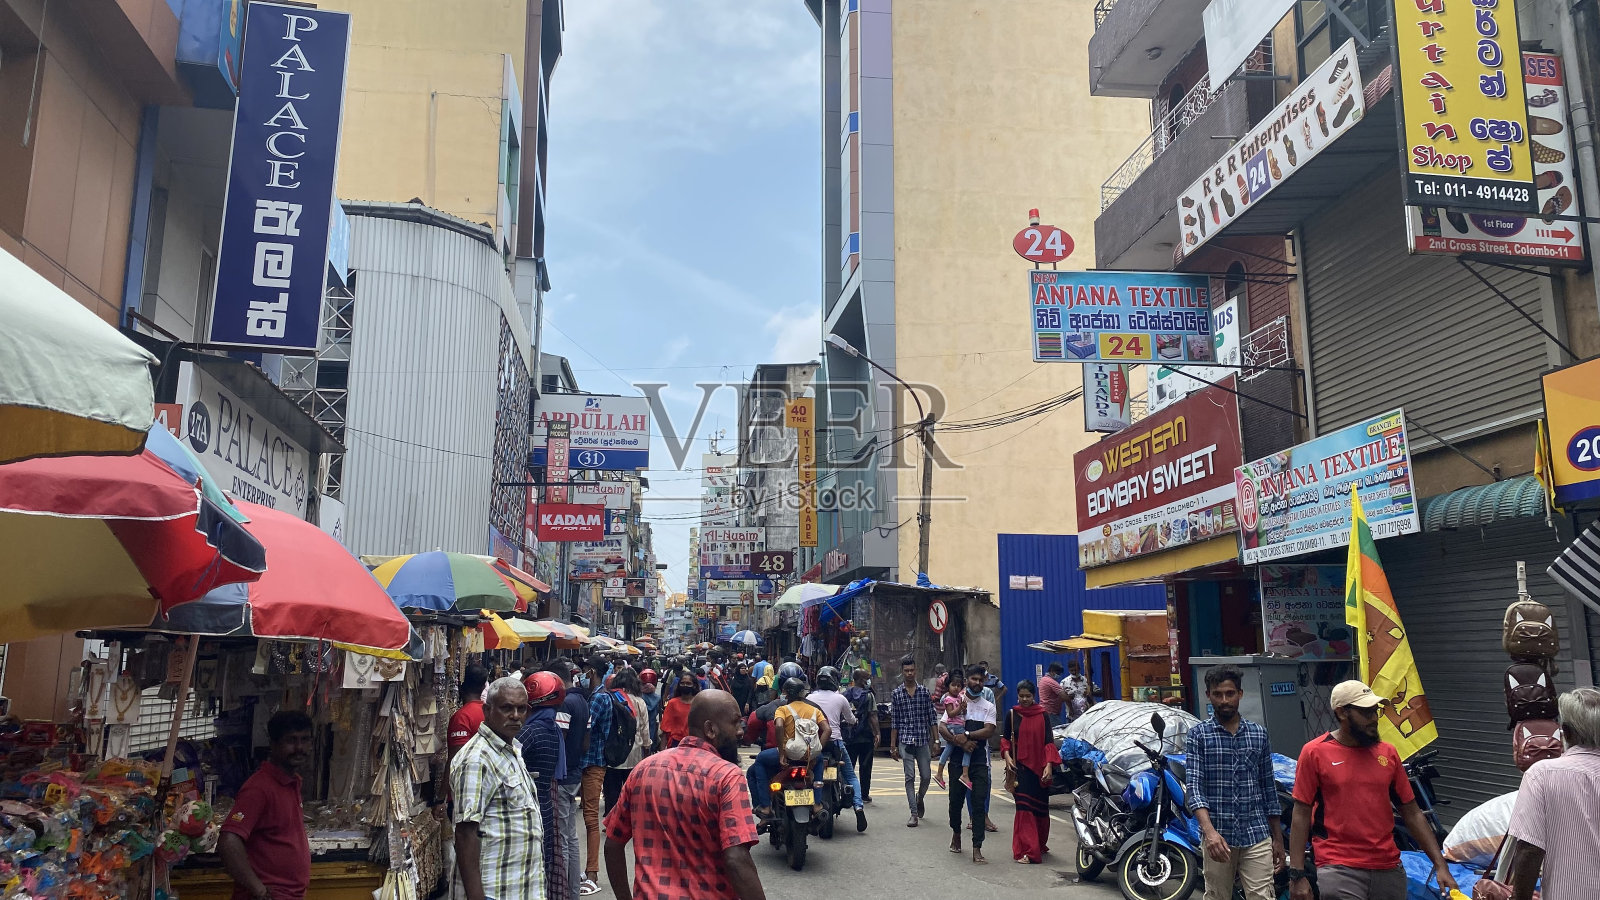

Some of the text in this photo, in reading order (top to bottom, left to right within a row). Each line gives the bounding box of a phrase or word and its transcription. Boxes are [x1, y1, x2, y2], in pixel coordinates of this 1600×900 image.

[1415, 0, 1456, 139] urtain
[263, 13, 319, 189] PALACE
[1202, 87, 1316, 197] R & R Enterprises
[1412, 145, 1473, 173] Shop
[1249, 161, 1266, 193] 24
[1415, 180, 1440, 195] Tel:
[1476, 185, 1530, 202] 4914428
[1483, 219, 1514, 229] 1st Floor
[1024, 229, 1066, 257] 24
[1429, 238, 1569, 258] 2nd Cross Street, Colombo-11
[1033, 273, 1058, 284] NEW
[1034, 284, 1208, 309] ANJANA TEXTILE
[1108, 336, 1144, 356] 24
[1094, 363, 1110, 417] IDLANDS
[791, 405, 807, 416] 40
[190, 411, 208, 444] 17A
[1369, 421, 1392, 434] BRANCH
[214, 392, 295, 498] PALACE
[1103, 415, 1188, 474] WESTERN
[584, 452, 599, 465] 31
[1259, 434, 1402, 500] ANJANA TEXTILE
[1087, 443, 1217, 518] BOMBAY SWEET
[1253, 463, 1271, 478] NEW
[1300, 508, 1317, 519] DEALERS
[1322, 500, 1341, 514] TEXTILES
[541, 514, 601, 526] KADAM
[705, 530, 759, 542] Al-Nuaim
[1268, 548, 1281, 557] CROSS
[759, 555, 785, 572] 48
[1266, 587, 1311, 598] ANJANA
[1271, 684, 1295, 694] 11W110
